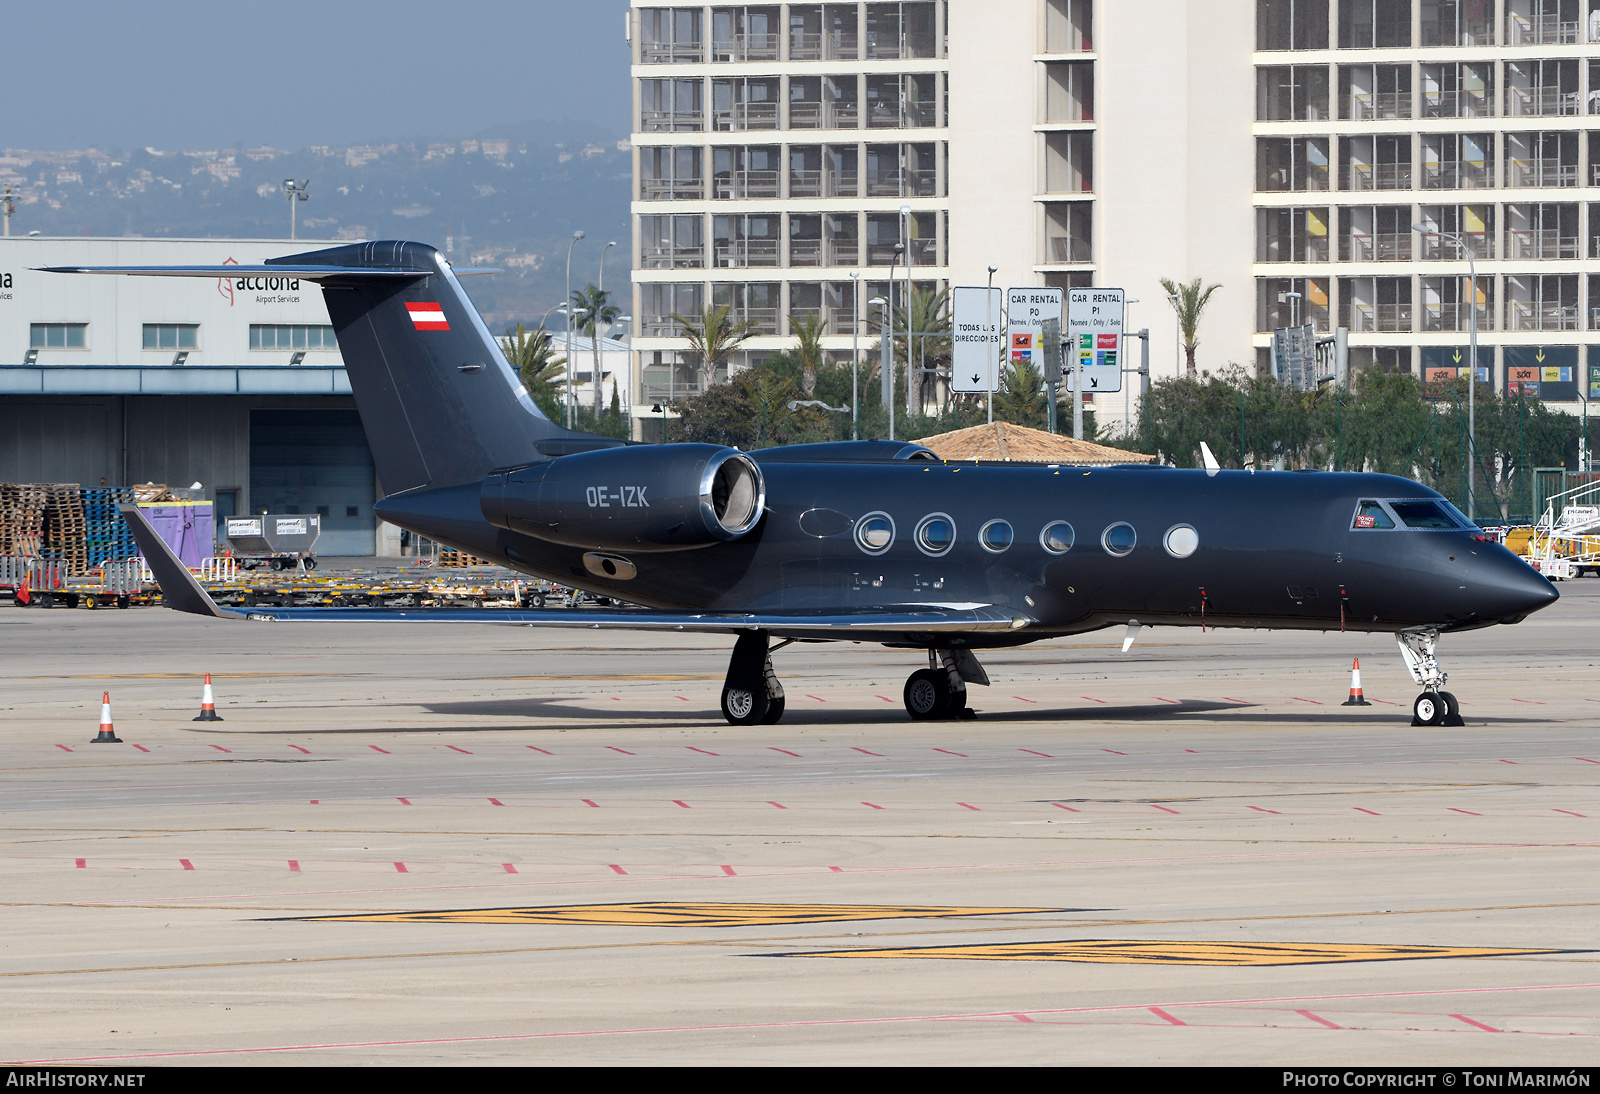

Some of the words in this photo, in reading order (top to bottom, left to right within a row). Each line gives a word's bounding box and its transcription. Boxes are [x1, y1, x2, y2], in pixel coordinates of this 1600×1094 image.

[255, 295, 276, 306] Airport
[277, 295, 300, 303] Services
[1011, 295, 1027, 303] CAR
[1030, 295, 1059, 304] RENTAL
[1071, 294, 1087, 303] CAR
[1092, 294, 1121, 303] RENTAL
[1092, 306, 1100, 315] P1
[1093, 318, 1105, 327] Only
[982, 324, 996, 332] LS
[586, 486, 650, 508] OE-IZK
